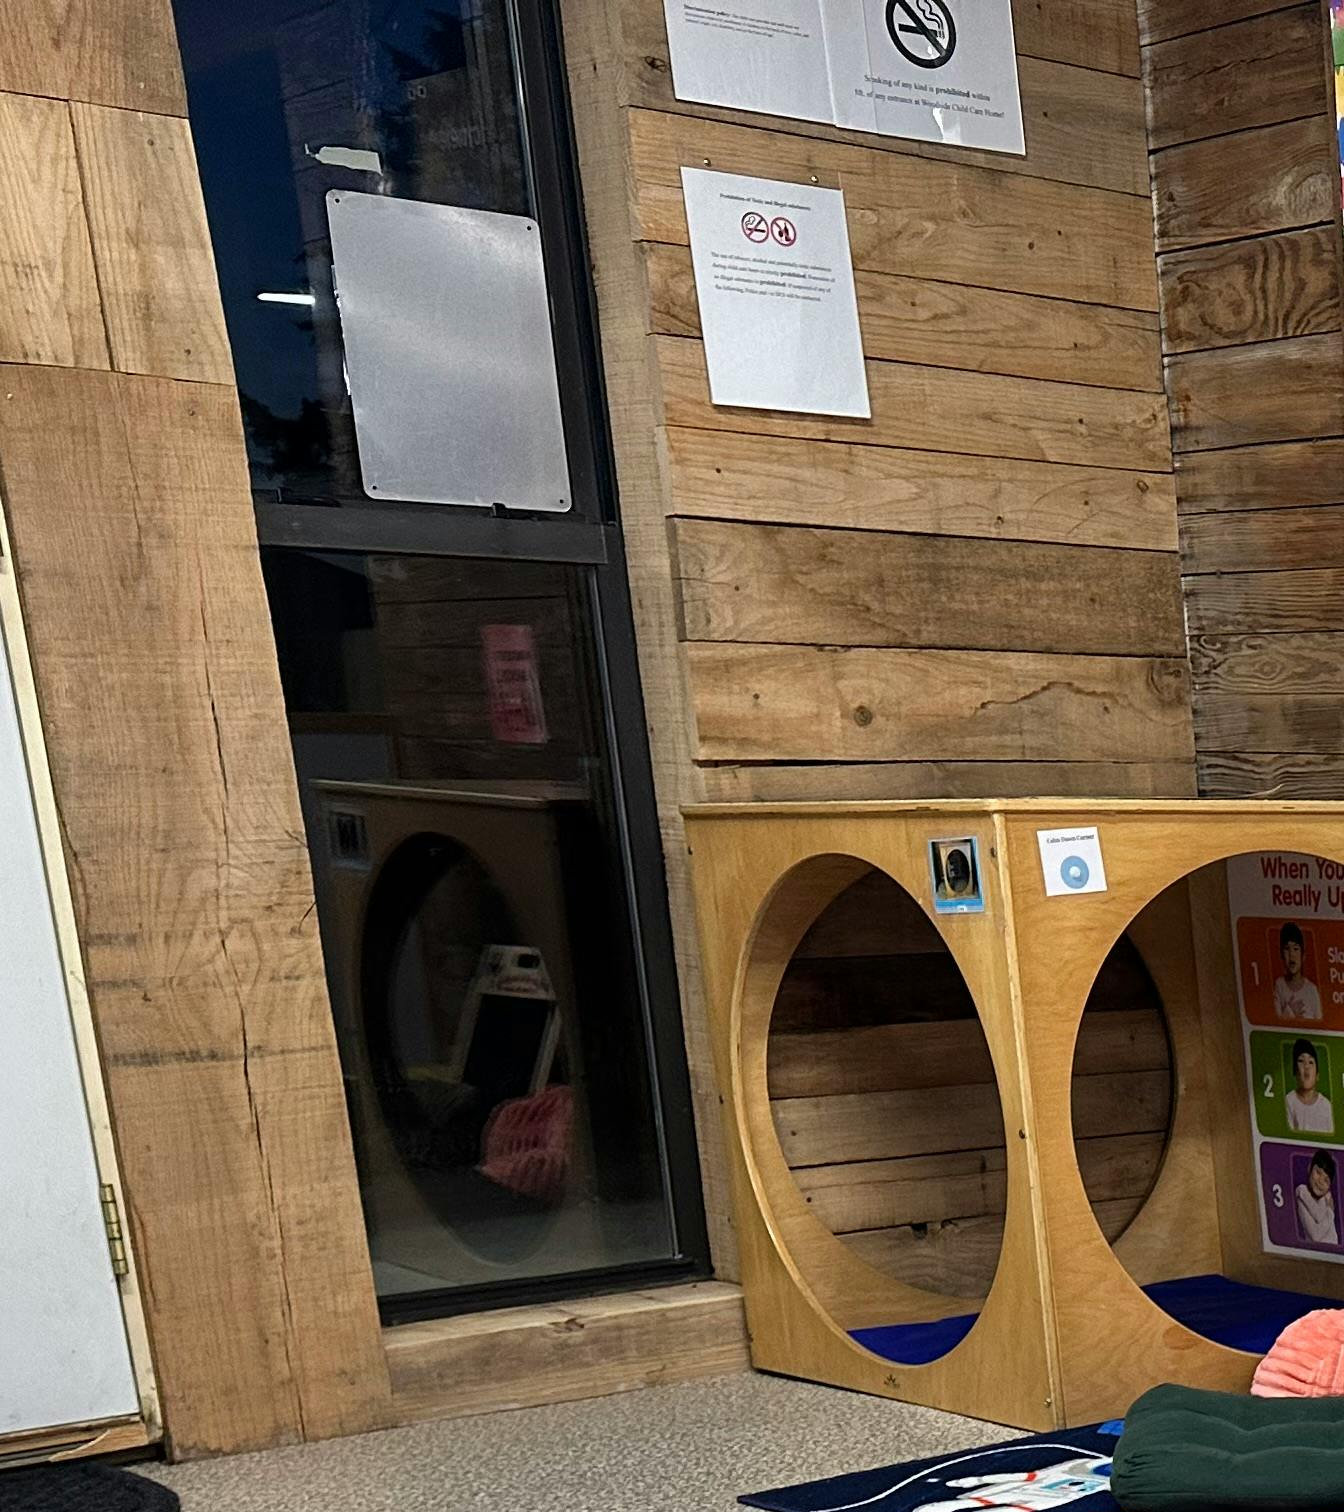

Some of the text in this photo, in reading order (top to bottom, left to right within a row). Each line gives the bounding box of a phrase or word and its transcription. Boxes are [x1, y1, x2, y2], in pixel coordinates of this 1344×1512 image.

[1261, 856, 1309, 879] When
[1272, 884, 1321, 912] Really
[1251, 961, 1260, 986] 1
[1263, 1074, 1274, 1098] 2
[1272, 1184, 1284, 1207] 3
